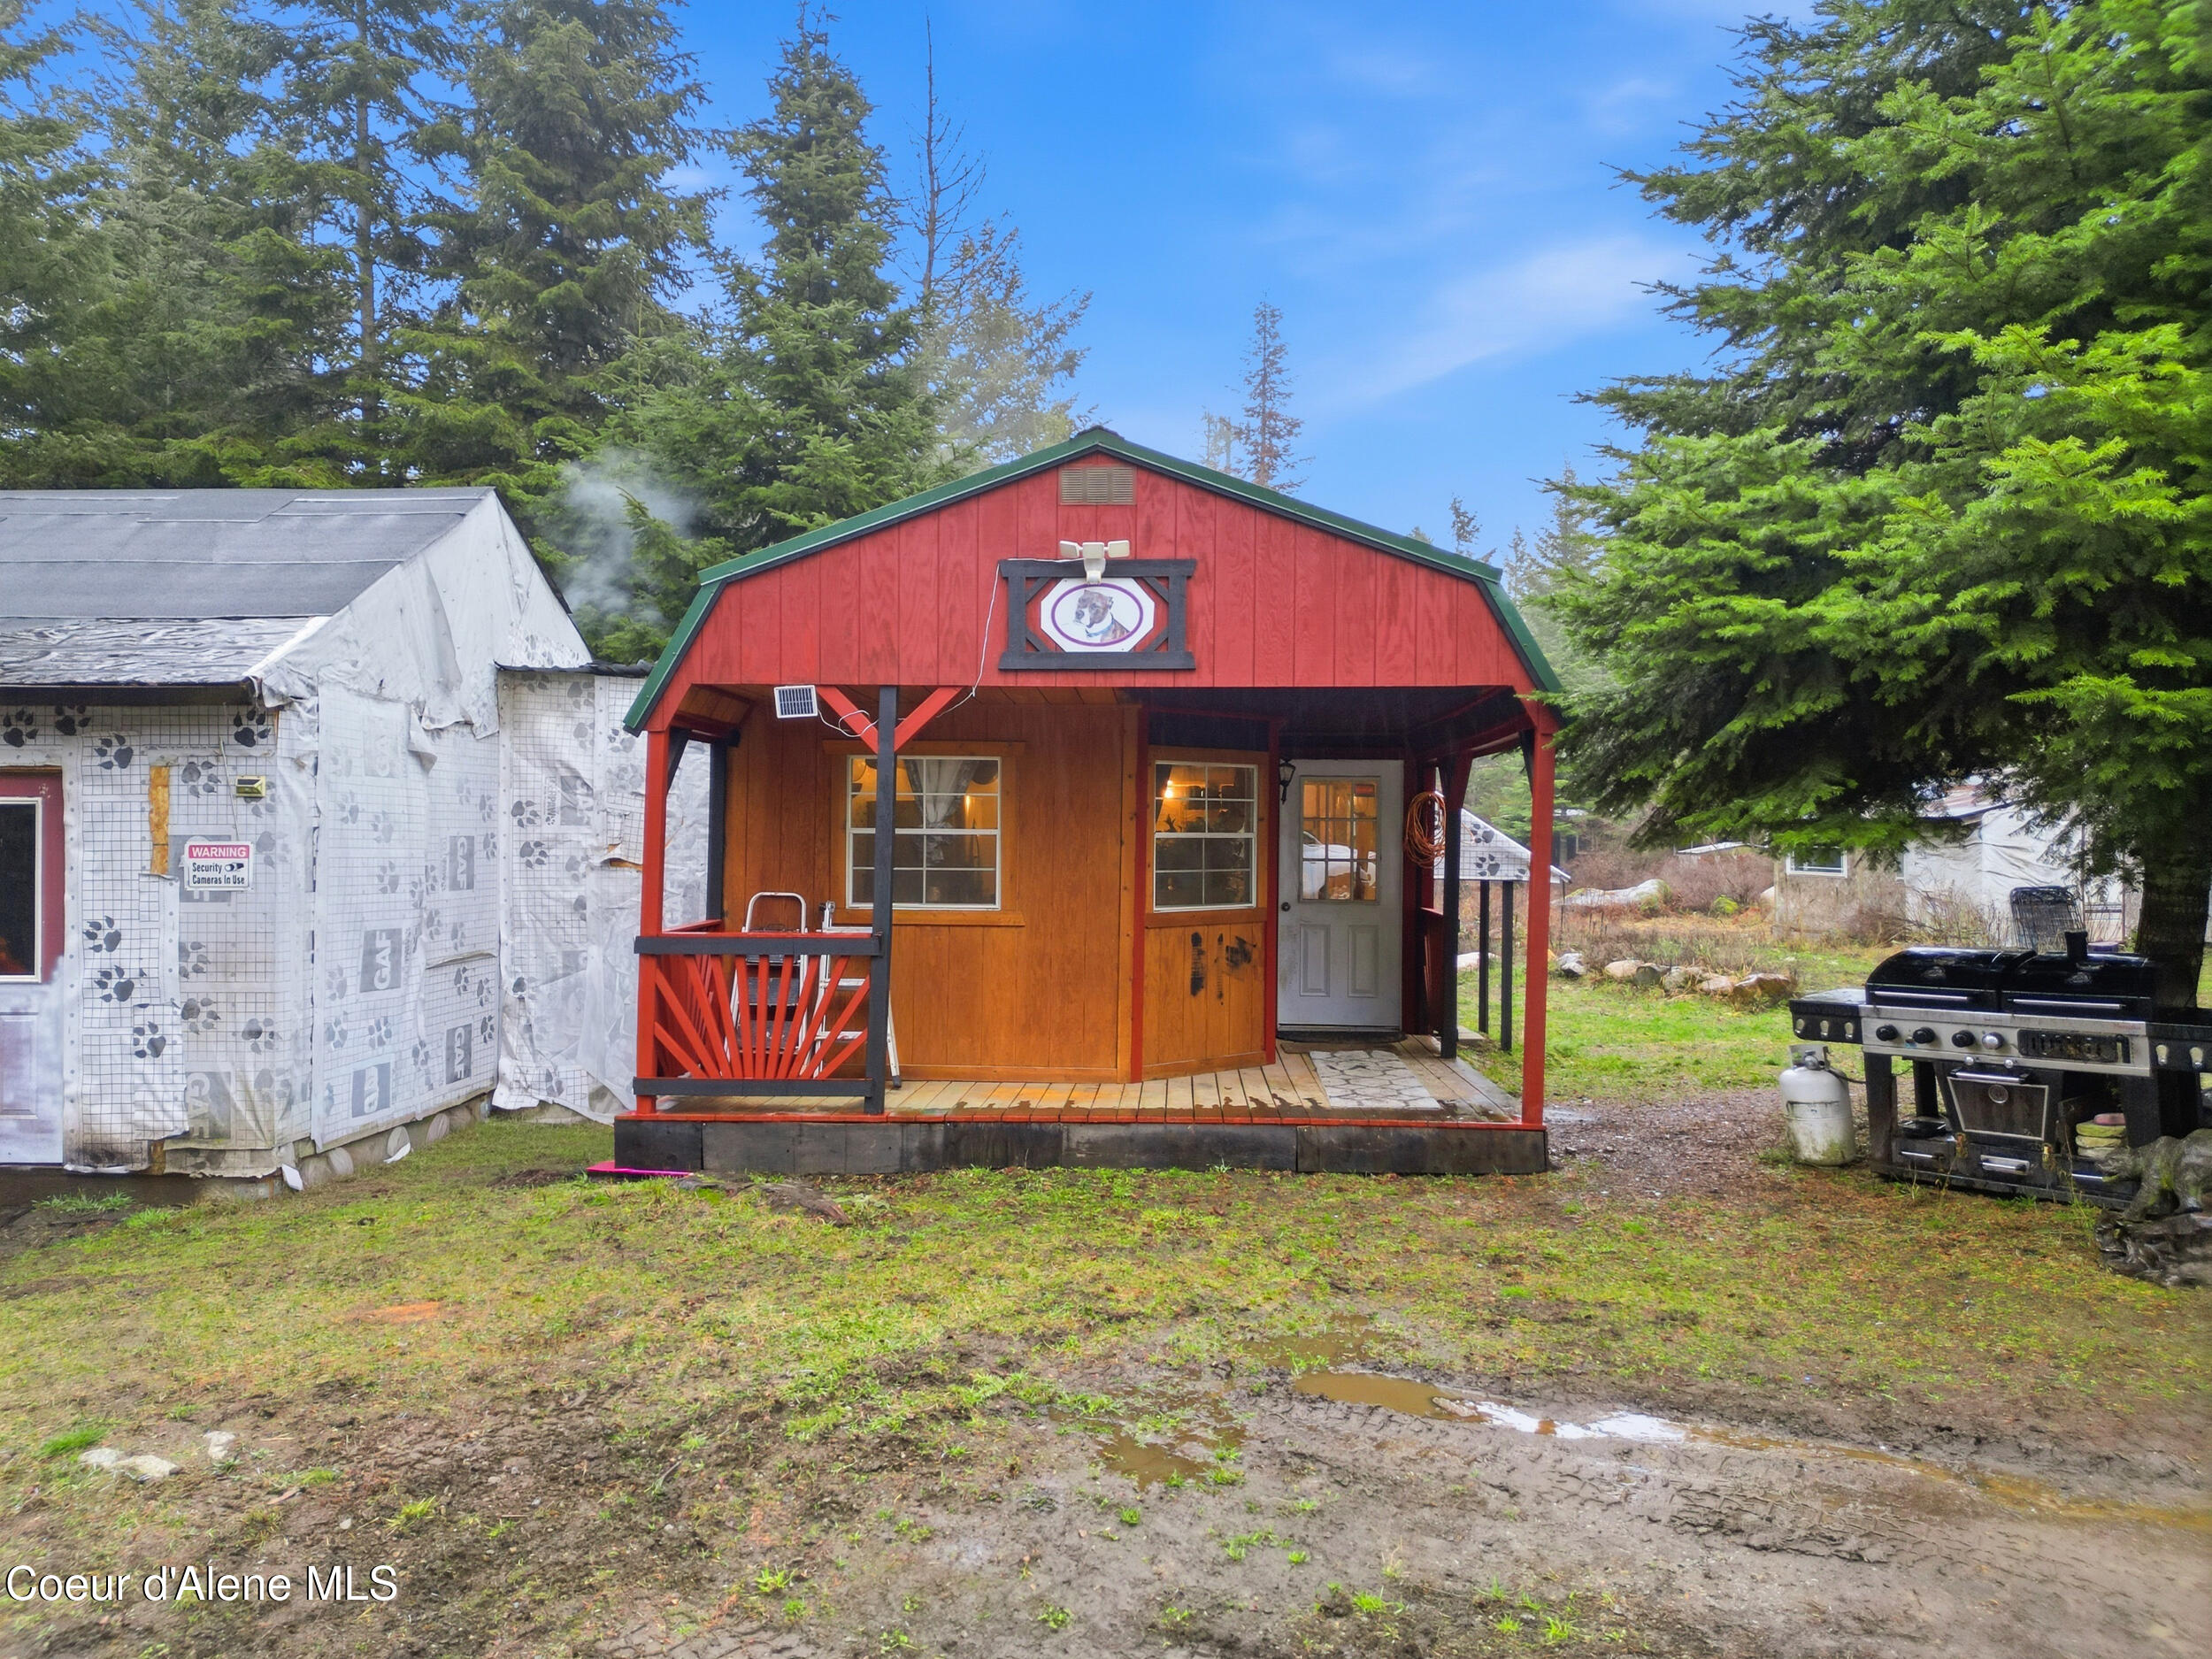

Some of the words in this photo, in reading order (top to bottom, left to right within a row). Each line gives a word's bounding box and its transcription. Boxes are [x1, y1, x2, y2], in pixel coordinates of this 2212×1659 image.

[192, 846, 246, 857] WARNING
[192, 862, 222, 874] Security
[457, 836, 467, 889] GAF
[192, 874, 222, 885] Cameras
[224, 874, 231, 885] In
[232, 874, 245, 885] Use
[373, 931, 391, 989] GAF
[454, 1026, 465, 1079] GAF
[186, 1072, 211, 1138] GAF
